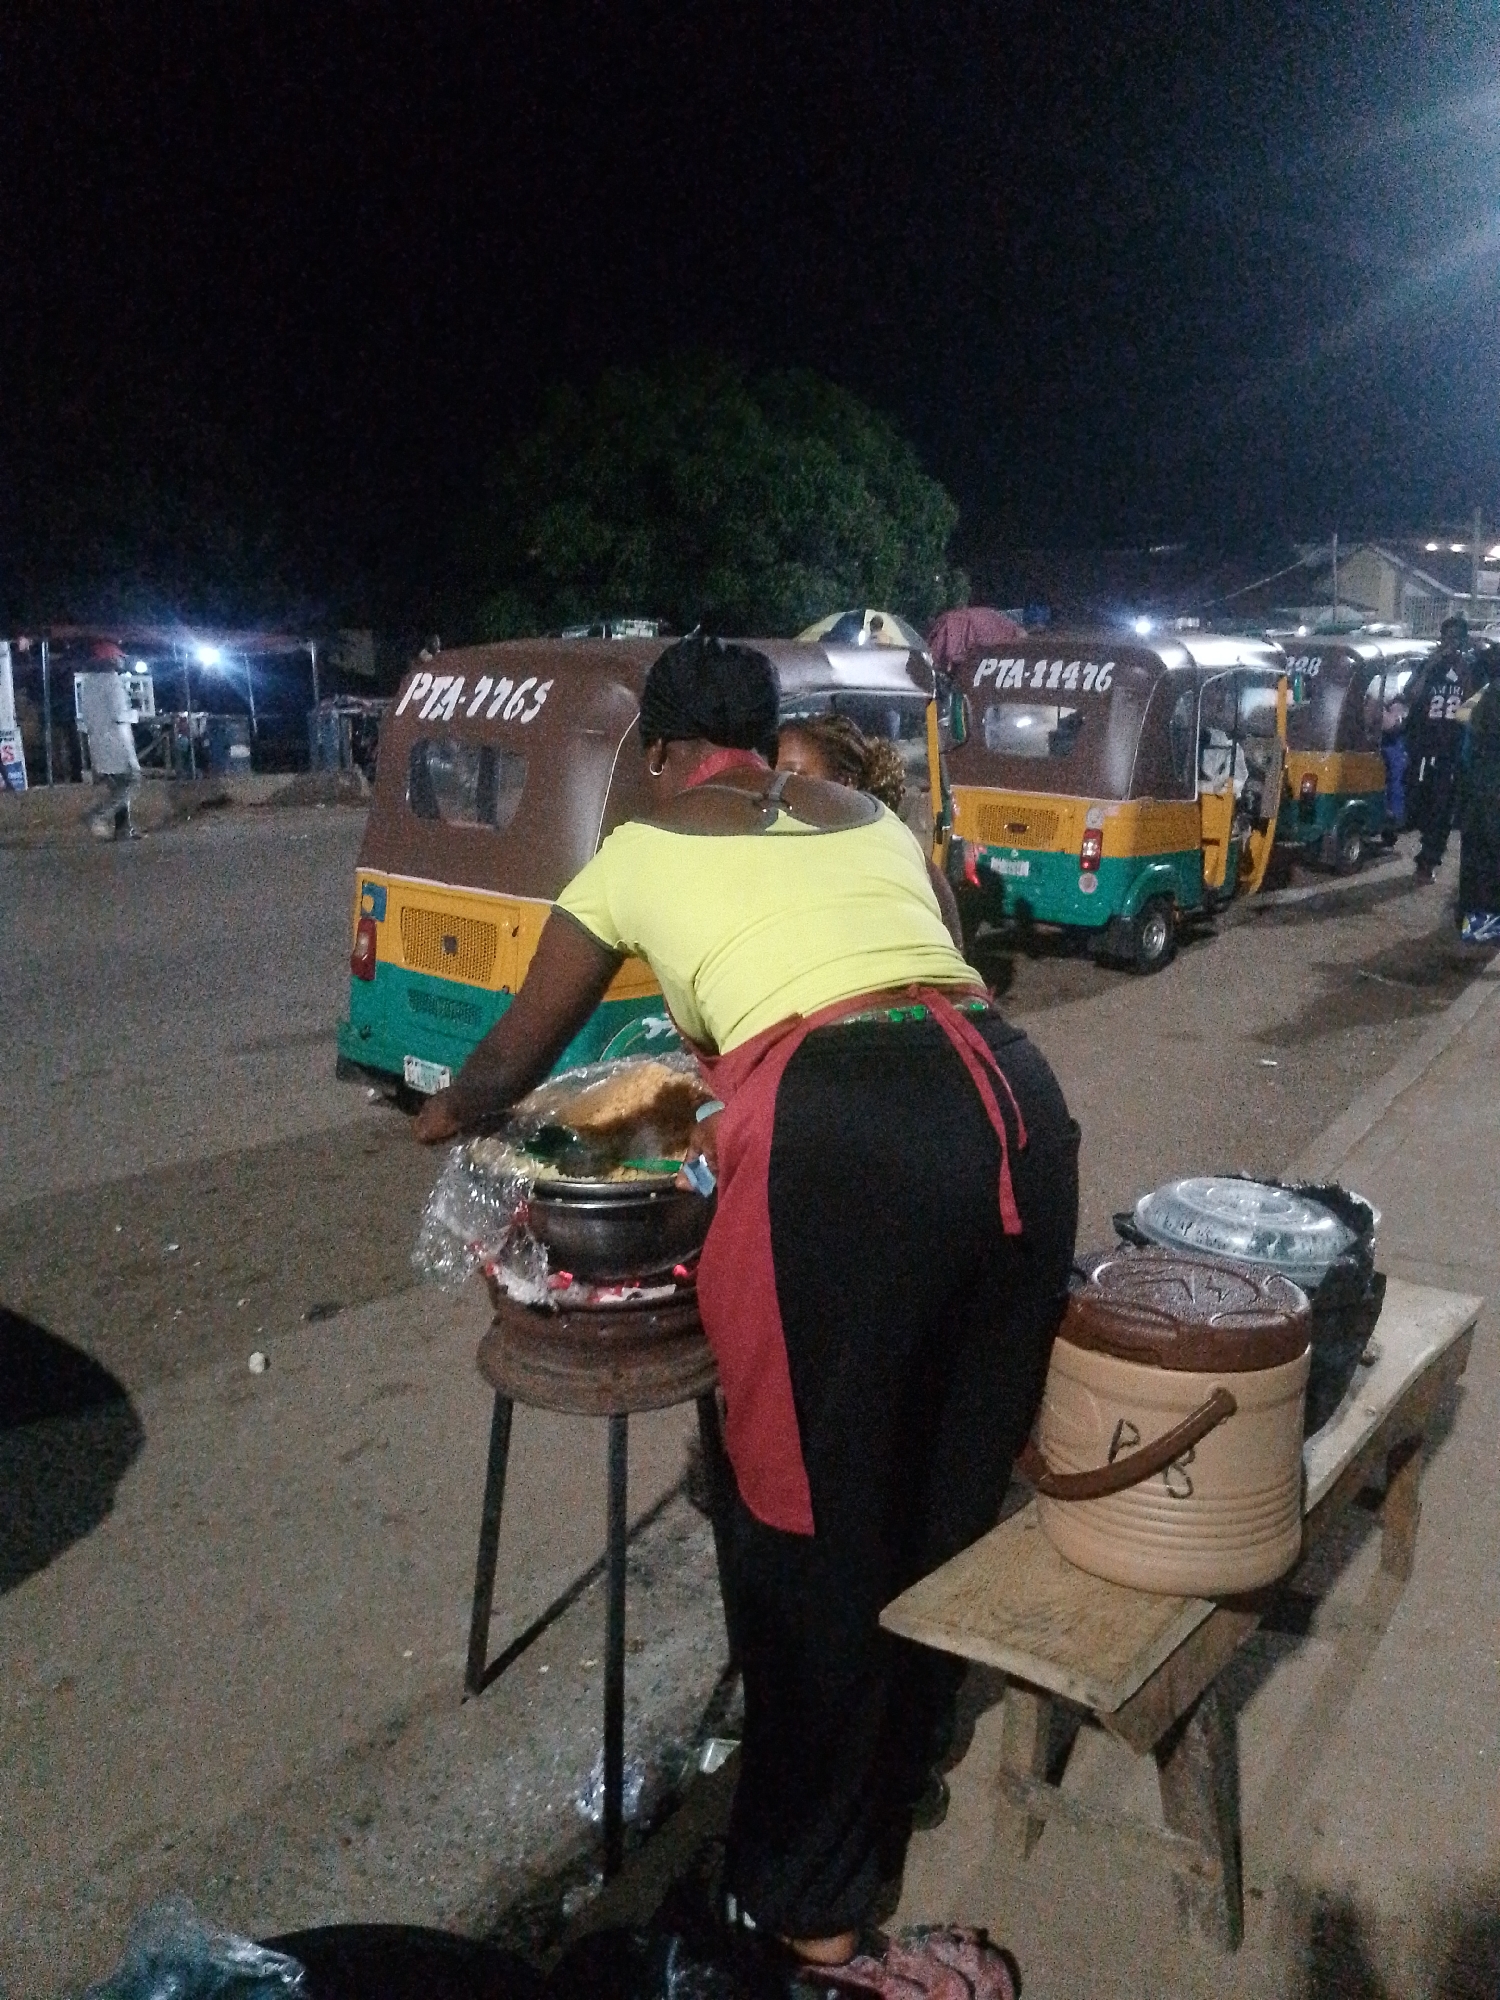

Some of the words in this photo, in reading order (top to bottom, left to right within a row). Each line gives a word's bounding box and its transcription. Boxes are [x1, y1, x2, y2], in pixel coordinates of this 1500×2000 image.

[973, 658, 1115, 692] PTA-11476
[395, 672, 554, 724] PTA-7765
[1428, 694, 1461, 719] 22
